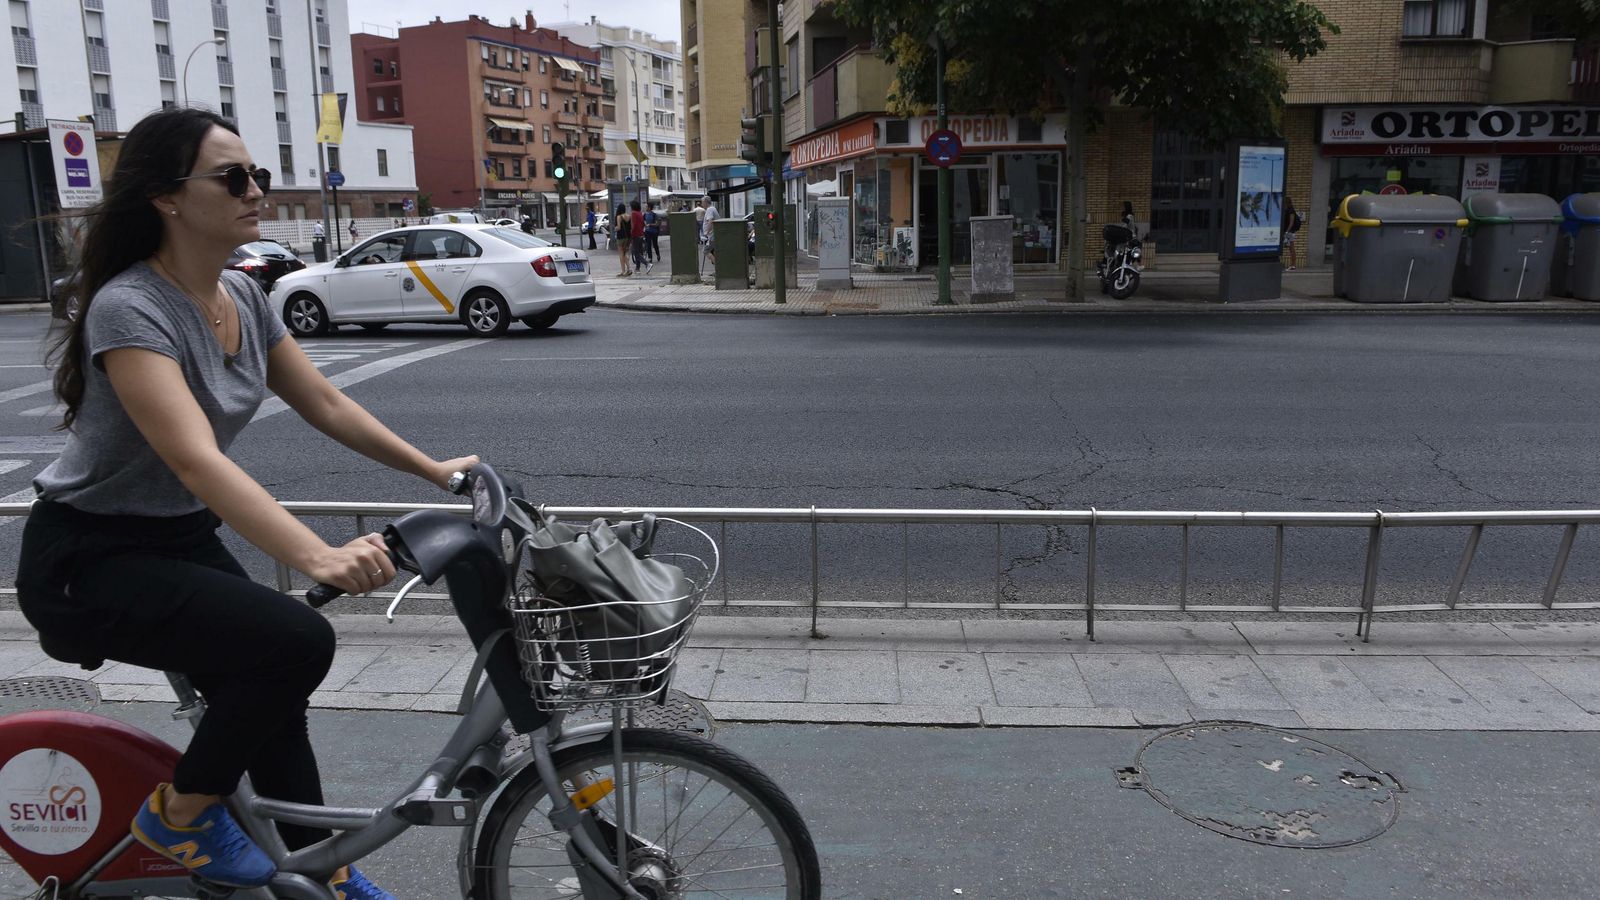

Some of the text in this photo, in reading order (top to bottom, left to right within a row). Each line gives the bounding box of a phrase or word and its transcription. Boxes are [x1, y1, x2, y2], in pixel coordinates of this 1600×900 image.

[920, 117, 1008, 144] OOPEDIA
[1329, 128, 1364, 136] Ariadna
[797, 131, 840, 164] ORTOPEDIA
[1384, 143, 1430, 155] Ariadna
[1465, 178, 1497, 186] Ariadna
[11, 824, 39, 833] Sevilla
[50, 825, 60, 833] tu
